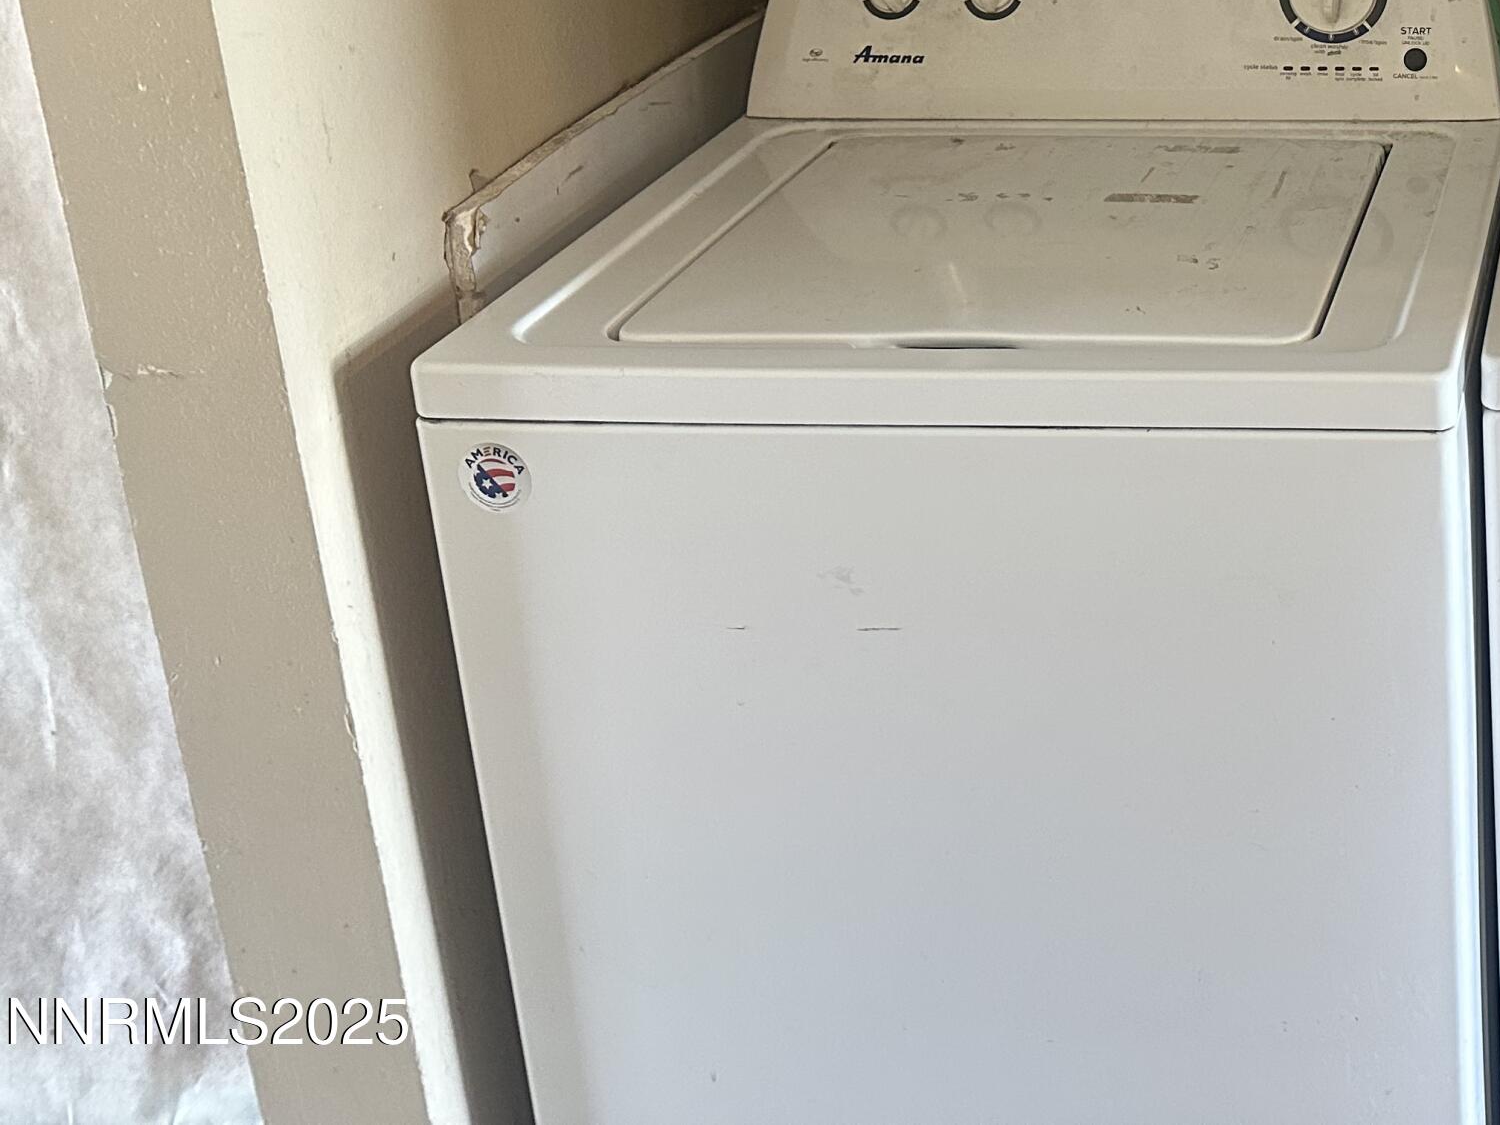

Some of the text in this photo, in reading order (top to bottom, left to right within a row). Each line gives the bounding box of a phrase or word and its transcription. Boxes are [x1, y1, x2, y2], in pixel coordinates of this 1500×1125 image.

[1400, 26, 1432, 35] START
[853, 45, 925, 64] Amana
[465, 446, 525, 475] AMERICA
